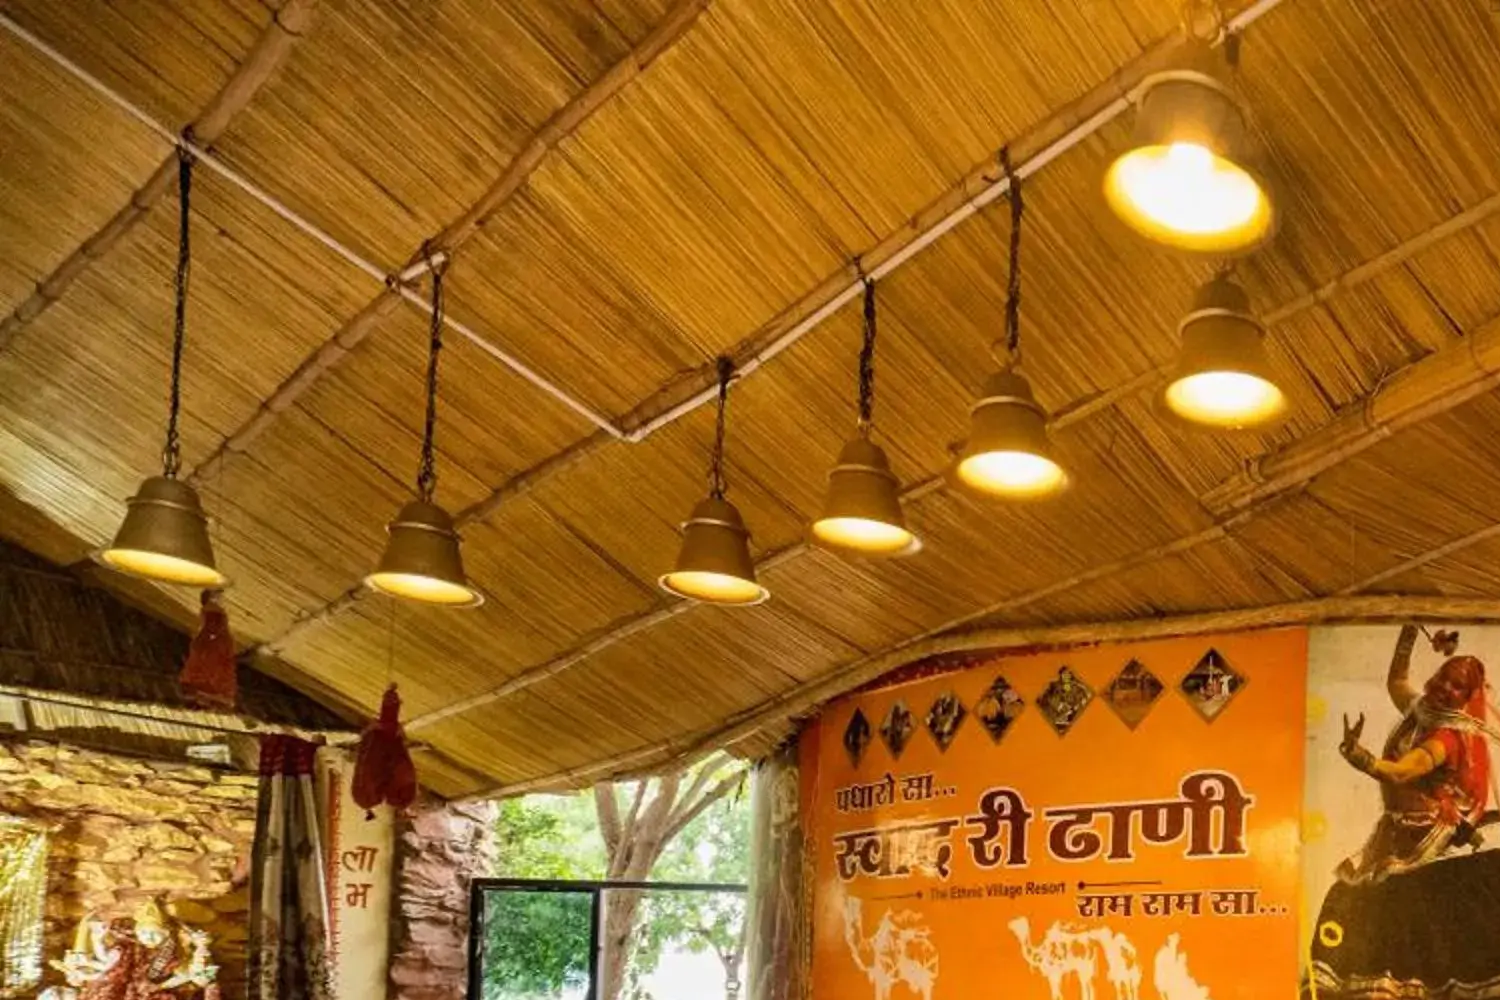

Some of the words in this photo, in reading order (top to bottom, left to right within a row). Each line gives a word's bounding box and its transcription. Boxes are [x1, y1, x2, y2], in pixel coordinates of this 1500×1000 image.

[966, 788, 1033, 867] री
[1045, 771, 1254, 862] ढाणी
[1025, 881, 1066, 895] Resort
[1077, 893, 1133, 918] राम
[1142, 892, 1201, 917] राम
